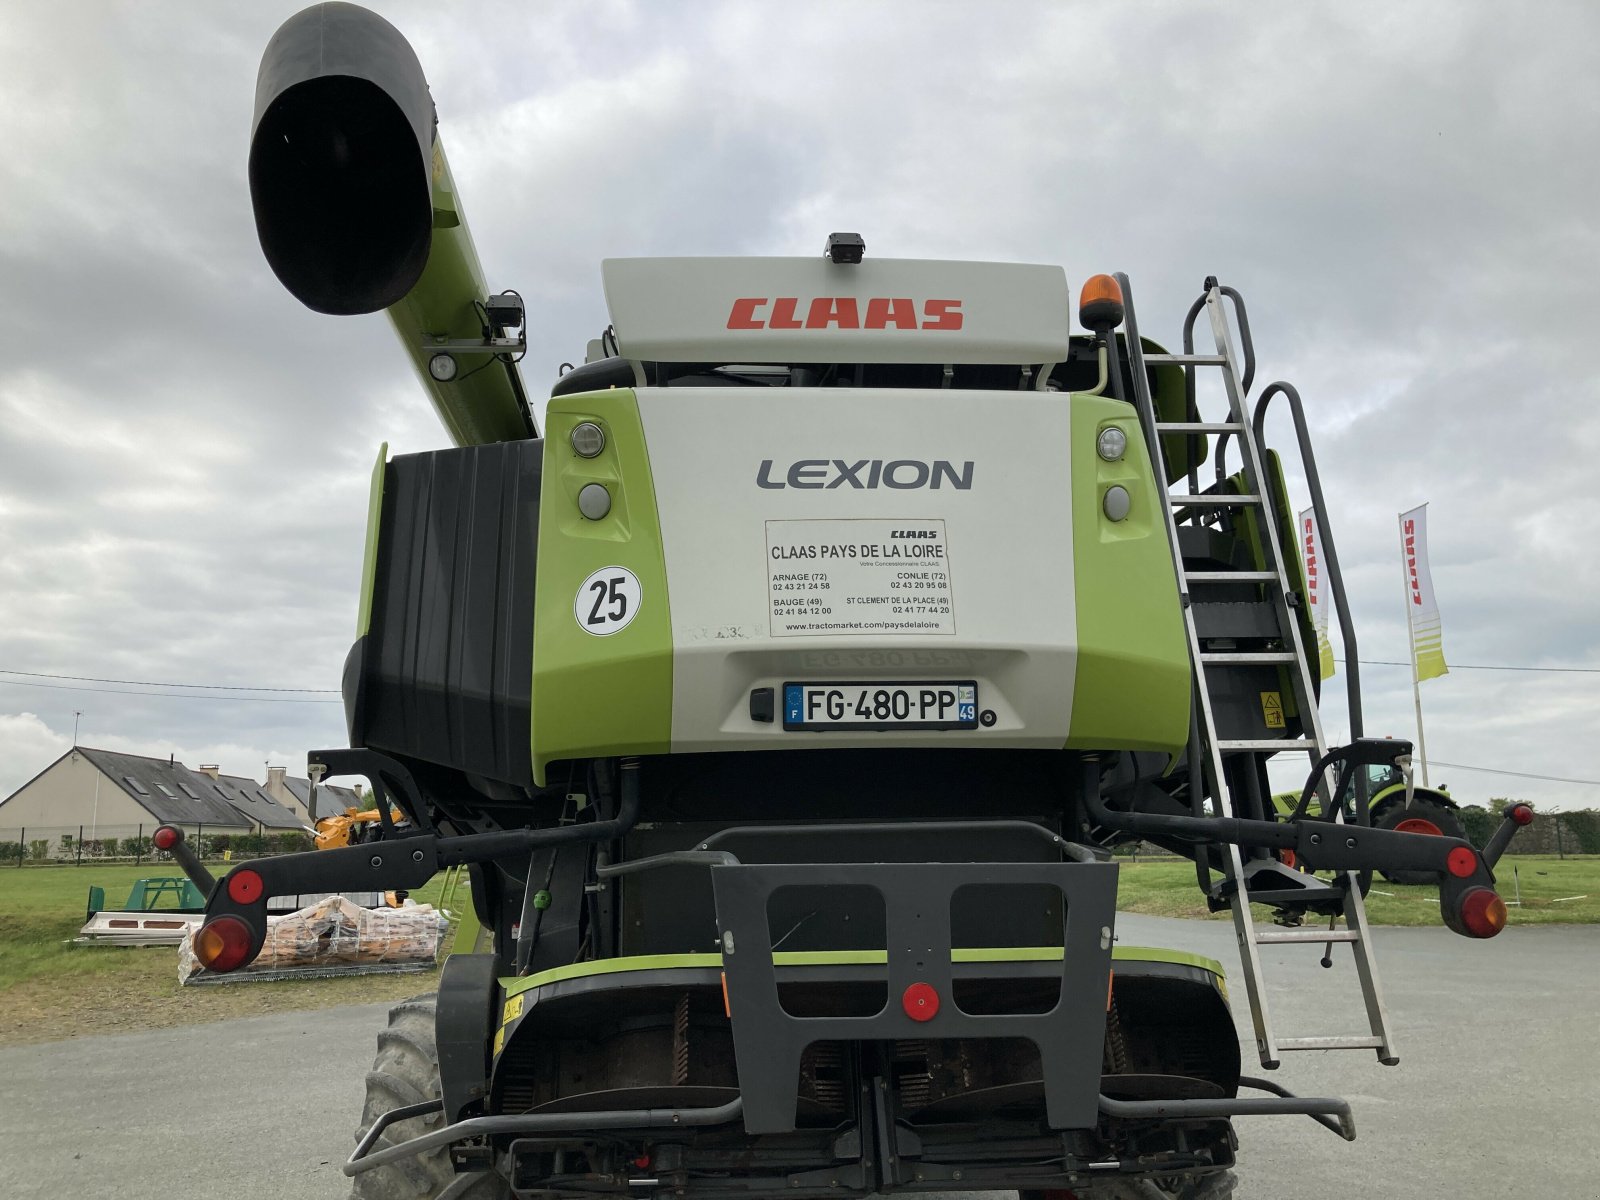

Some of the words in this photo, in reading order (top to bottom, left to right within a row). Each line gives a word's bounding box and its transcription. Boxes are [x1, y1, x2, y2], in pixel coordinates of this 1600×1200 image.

[727, 298, 963, 330] CLAAS
[756, 460, 974, 490] LEXION
[890, 530, 937, 539] CLAAS
[771, 545, 817, 560] CLAAS
[820, 544, 857, 559] PAYS
[860, 544, 879, 558] DE
[882, 544, 901, 558] LA
[904, 544, 943, 558] LOIRE
[1404, 519, 1422, 606] CLAAS
[811, 573, 827, 582] (72)
[897, 572, 929, 580] CONLIE
[931, 572, 946, 581] (72)
[773, 583, 783, 591] 02
[820, 582, 831, 590] 58
[587, 577, 627, 625] 25
[773, 598, 805, 607] BAUGE
[806, 598, 823, 607] (49)
[846, 597, 856, 605] ST
[857, 596, 889, 604] CLEMENT
[937, 597, 949, 605] (49)
[774, 608, 784, 616] 02
[785, 608, 795, 616] 41
[797, 607, 808, 615] 84
[810, 607, 820, 615] 12
[821, 607, 832, 615] 00
[892, 606, 903, 614] 02
[904, 606, 914, 614] 41
[916, 606, 926, 614] 77
[928, 606, 938, 614] 44
[940, 606, 950, 614] 20
[786, 621, 940, 631] www.tractomarket.com/paysdelaloire
[791, 710, 798, 719] F
[807, 690, 956, 720] FG-480-PP
[959, 705, 975, 720] 49
